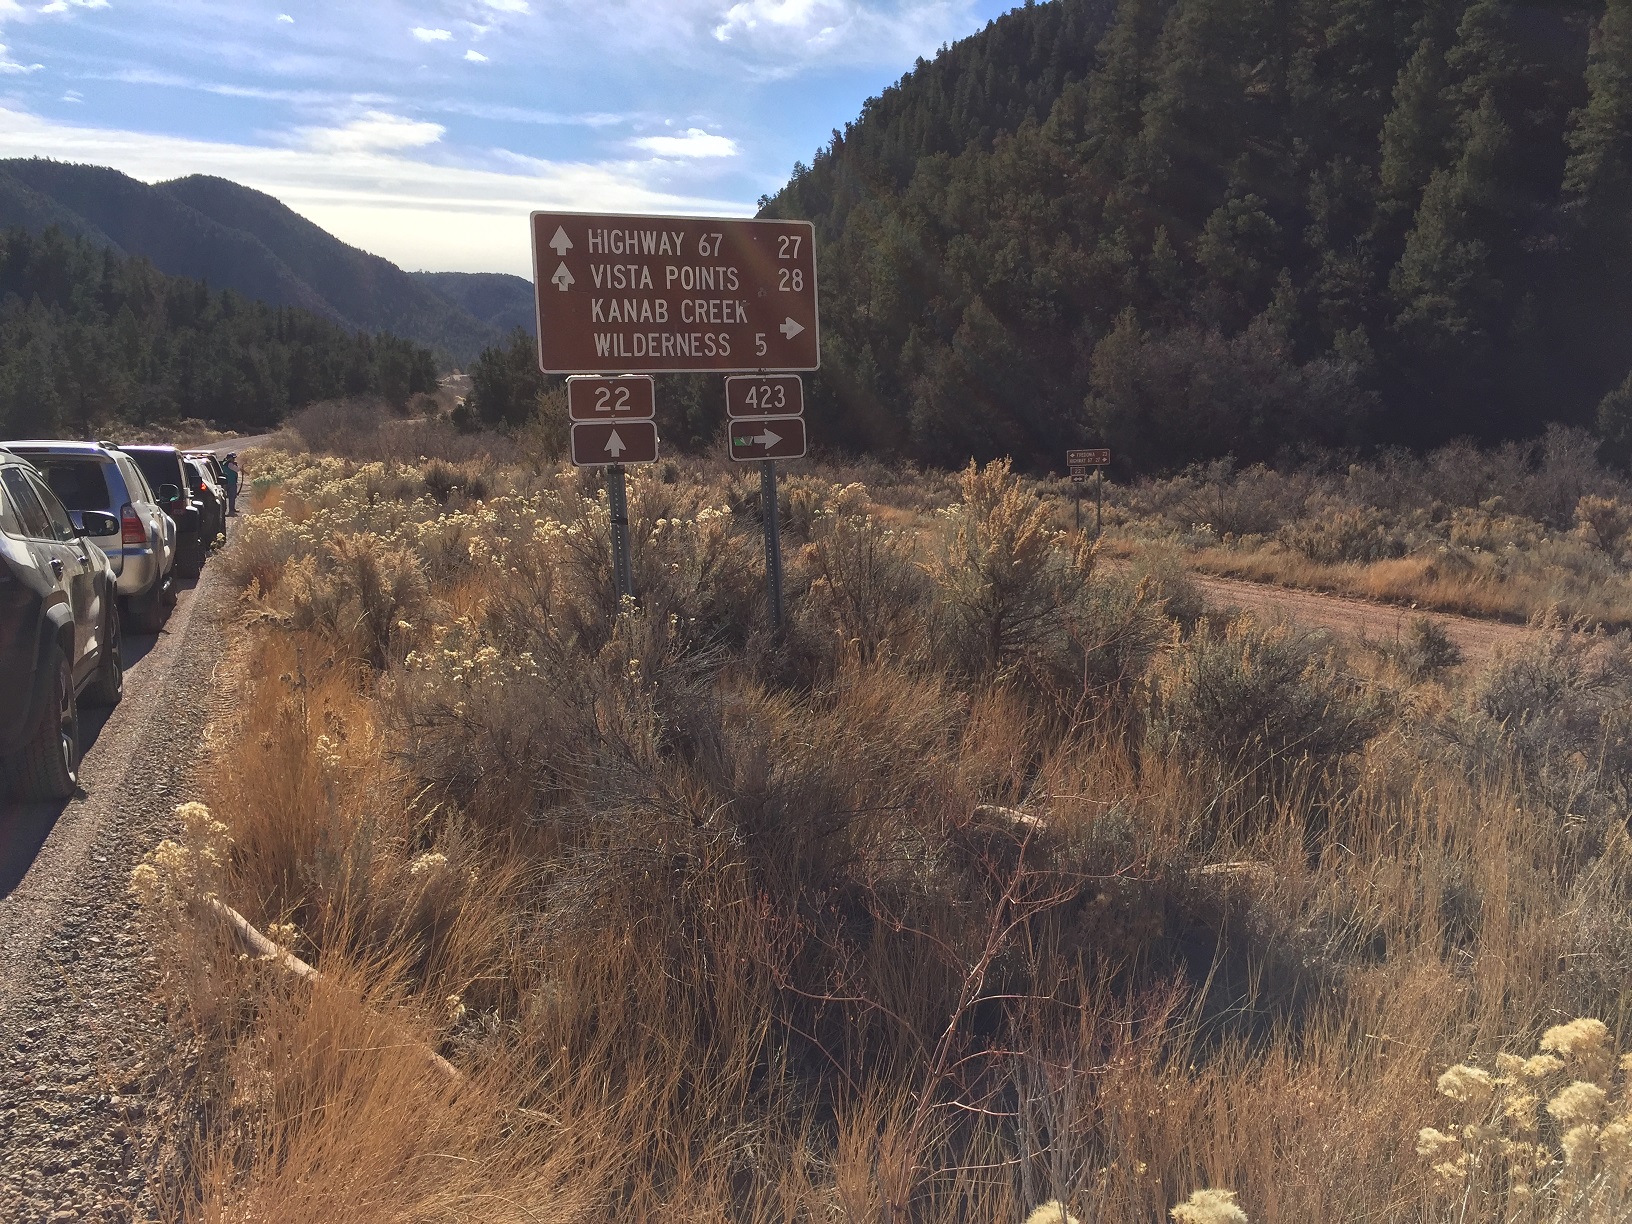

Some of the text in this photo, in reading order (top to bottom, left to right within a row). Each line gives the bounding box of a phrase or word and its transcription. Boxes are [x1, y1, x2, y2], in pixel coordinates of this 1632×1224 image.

[588, 229, 802, 259] HIGHWAY 67 27
[590, 264, 804, 292] VISTA POINTS 28
[591, 298, 748, 324] KANAB CREEK
[594, 332, 768, 357] WILDERNESS 5
[594, 387, 631, 412] 22
[745, 384, 786, 409] 423
